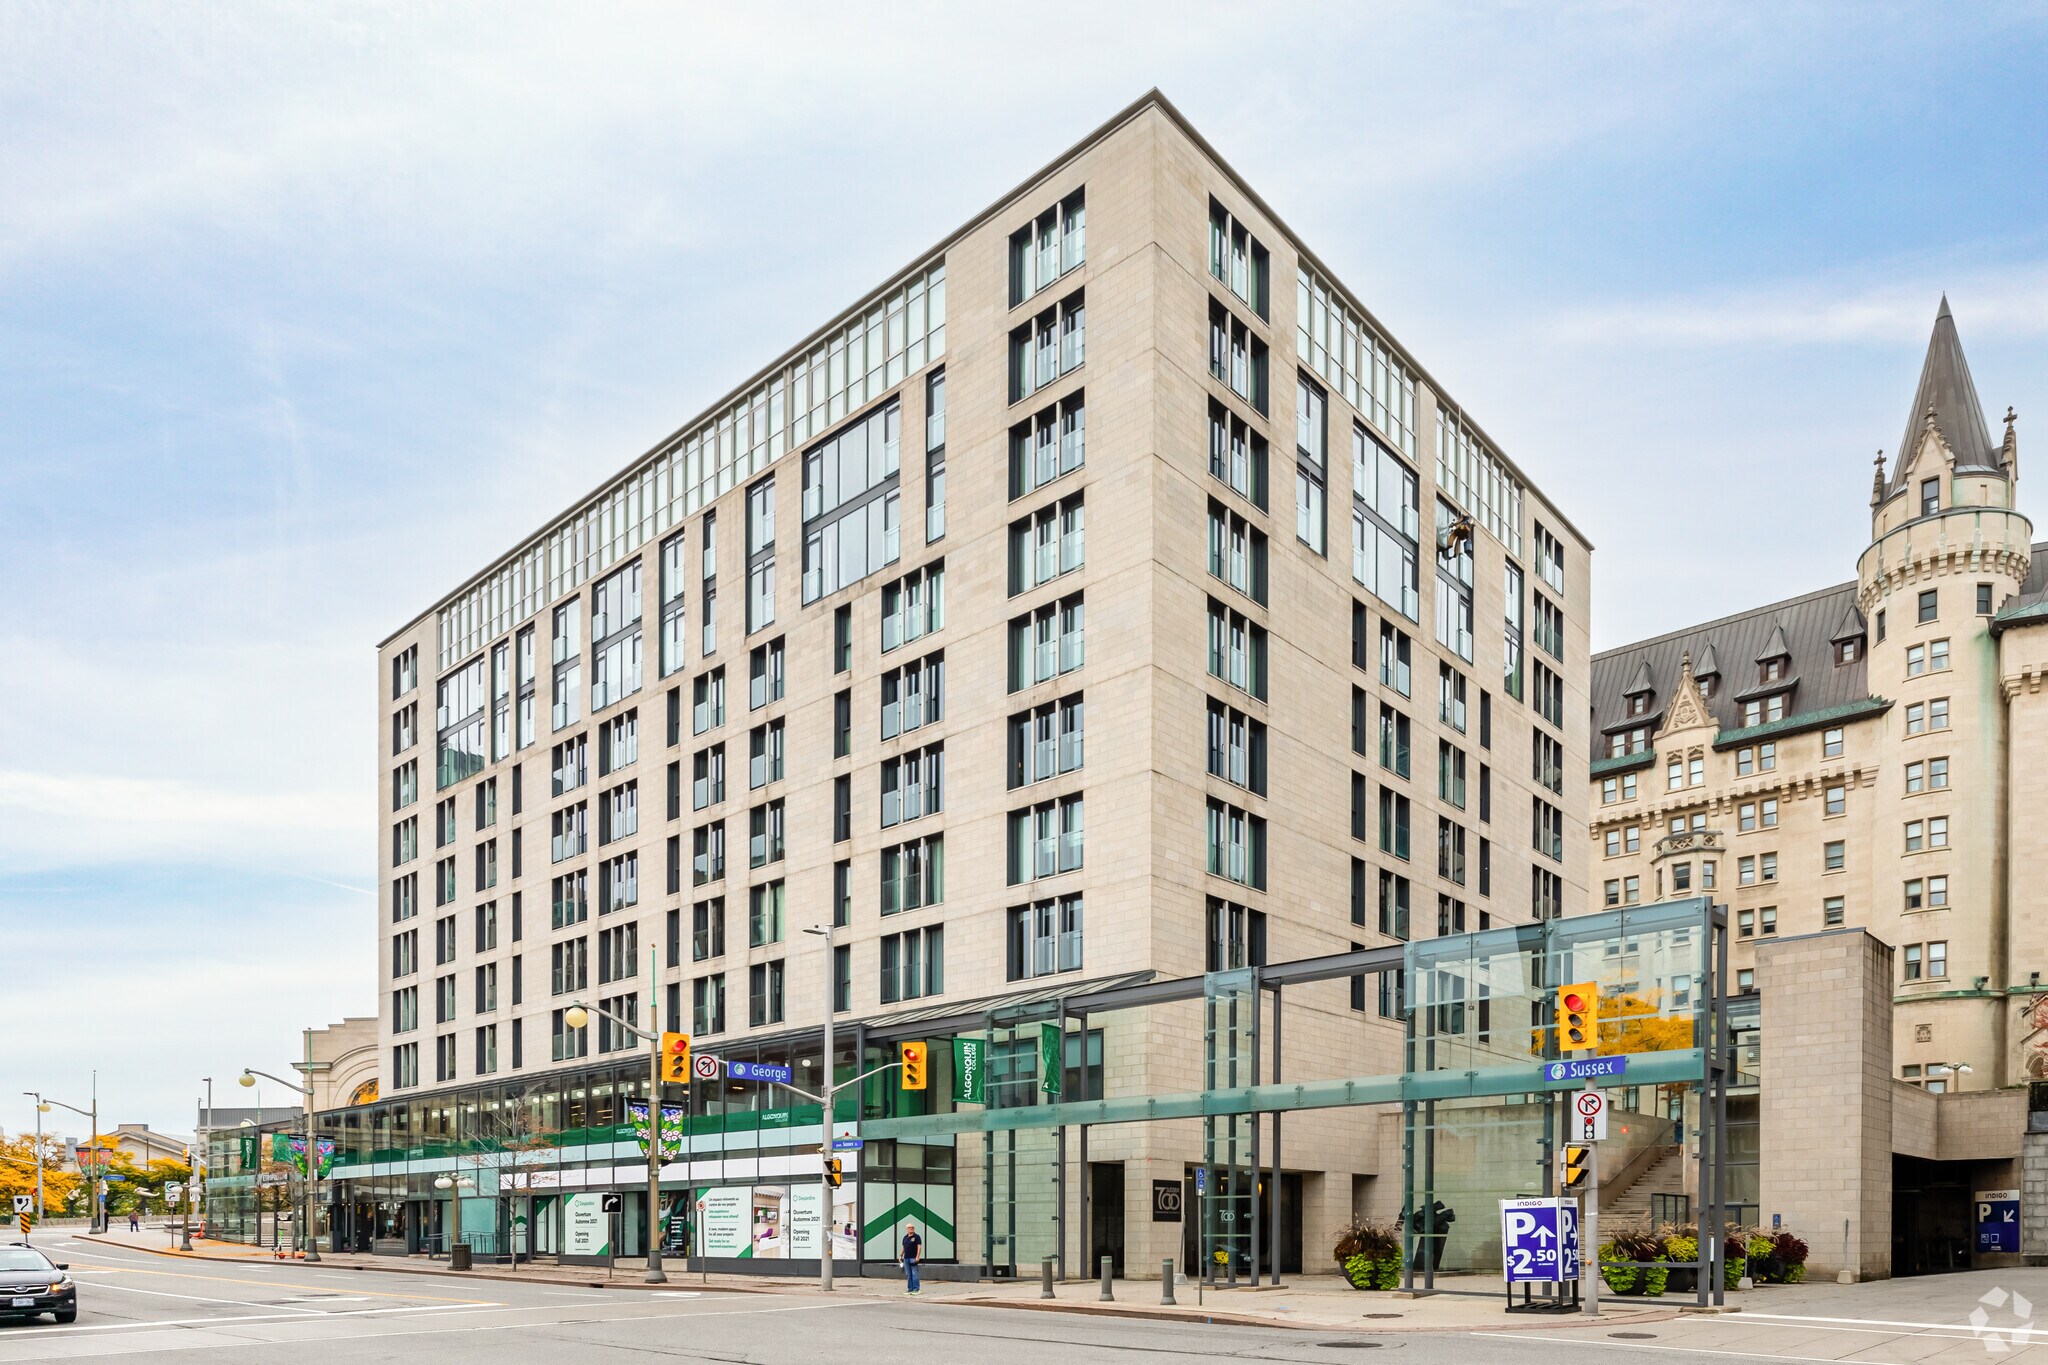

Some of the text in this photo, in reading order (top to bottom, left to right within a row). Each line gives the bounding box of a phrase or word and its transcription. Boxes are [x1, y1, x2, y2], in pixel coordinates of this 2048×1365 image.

[751, 1065, 787, 1081] George
[963, 1042, 972, 1100] ALGONQUIN
[1570, 1062, 1613, 1077] Sussex
[1155, 1187, 1180, 1210] 700
[1219, 1210, 1235, 1221] 700
[1979, 1203, 1992, 1223] P
[1506, 1212, 1536, 1247] P
[1561, 1209, 1573, 1245] P
